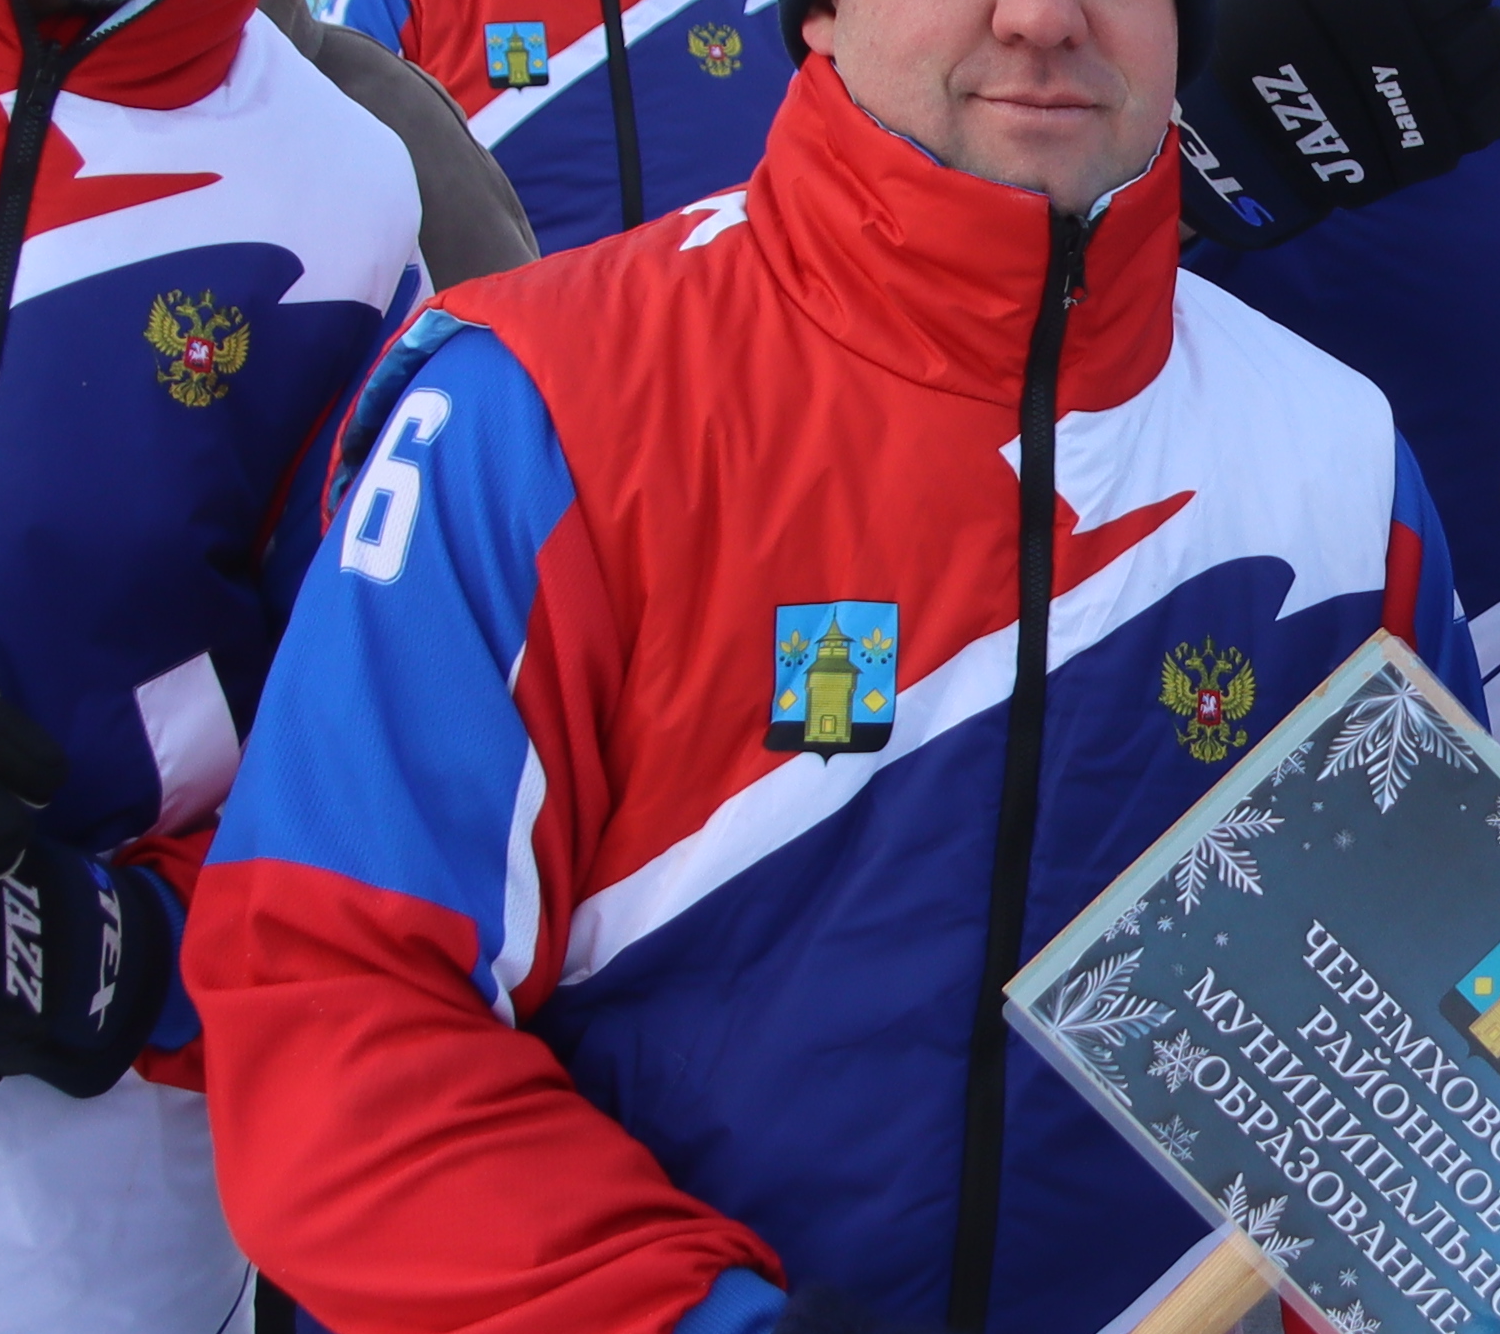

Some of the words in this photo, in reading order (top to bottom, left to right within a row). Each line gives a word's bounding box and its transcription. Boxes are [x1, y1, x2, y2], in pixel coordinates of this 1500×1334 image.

[1251, 64, 1365, 184] JAZZ
[1371, 66, 1424, 148] bandy
[340, 387, 452, 585] 6
